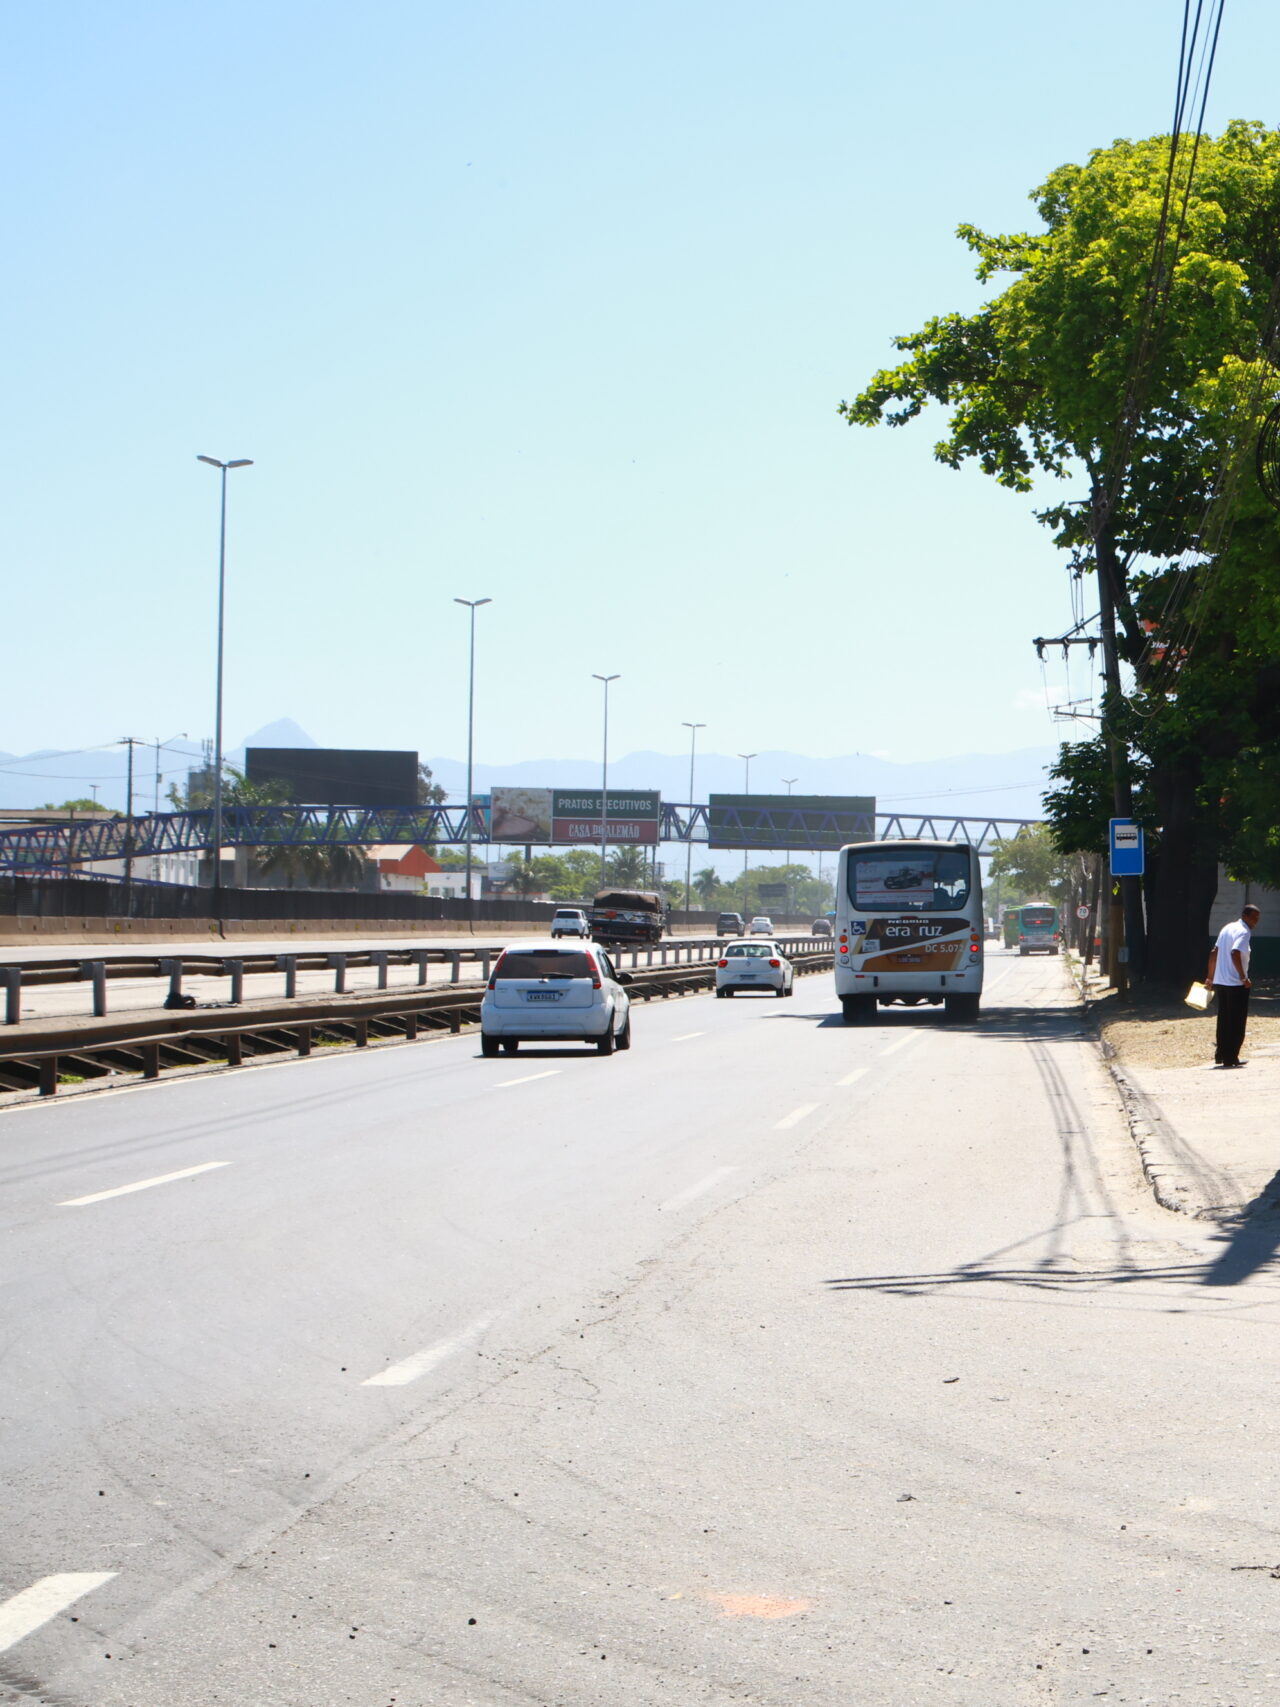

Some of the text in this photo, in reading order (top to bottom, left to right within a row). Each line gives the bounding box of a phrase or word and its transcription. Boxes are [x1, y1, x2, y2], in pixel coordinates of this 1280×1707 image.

[558, 798, 652, 811] PRATOS EECUTIVOS
[568, 823, 591, 838] CASA
[606, 823, 640, 839] ALEMÃO
